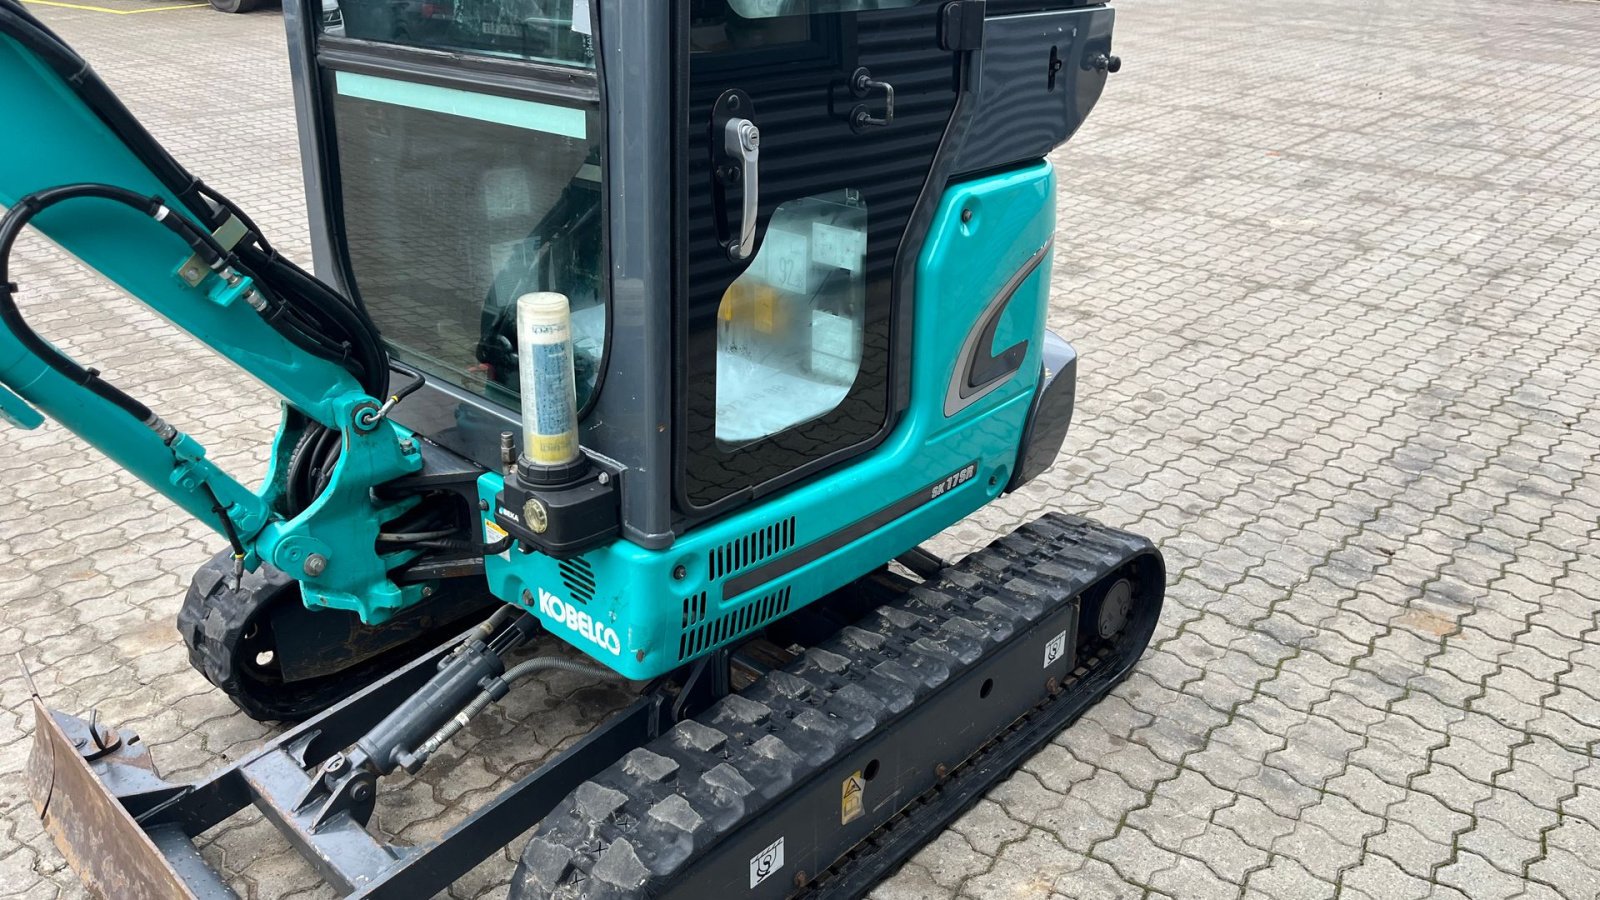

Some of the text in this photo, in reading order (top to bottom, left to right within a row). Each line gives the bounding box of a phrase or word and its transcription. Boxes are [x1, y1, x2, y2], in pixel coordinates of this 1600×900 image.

[931, 465, 974, 499] SK 17SR
[538, 587, 621, 656] KOBELCO
